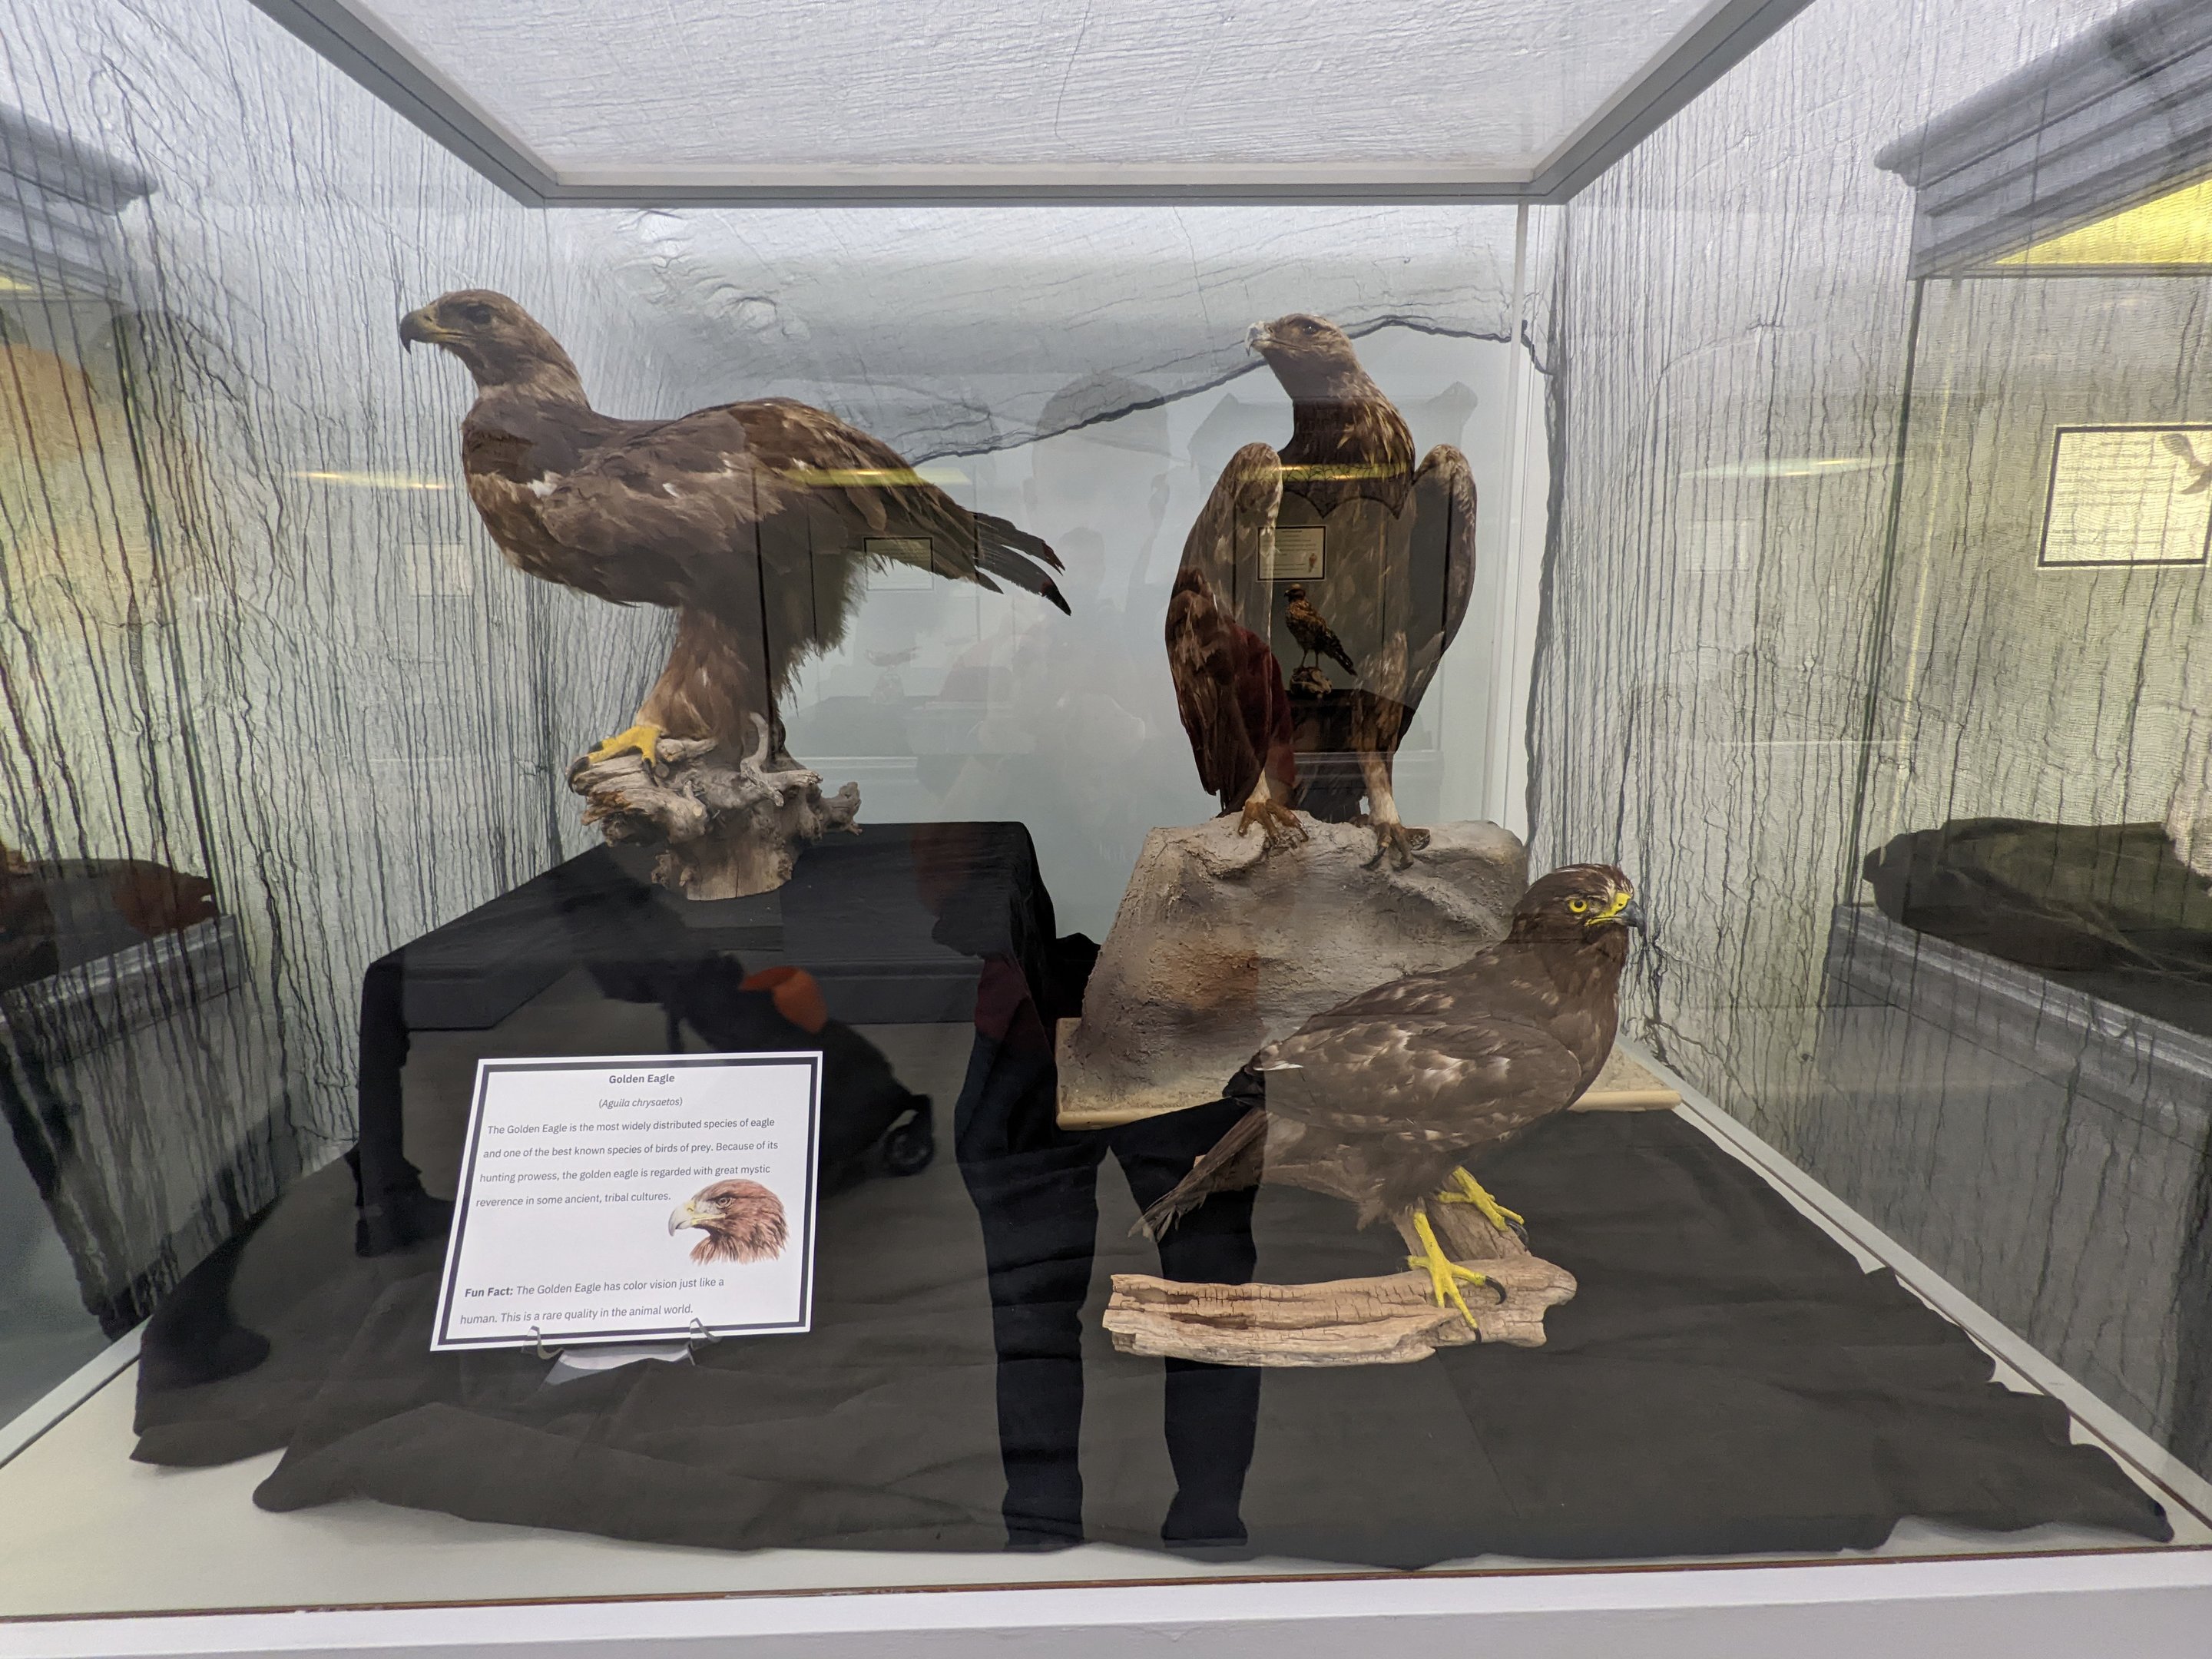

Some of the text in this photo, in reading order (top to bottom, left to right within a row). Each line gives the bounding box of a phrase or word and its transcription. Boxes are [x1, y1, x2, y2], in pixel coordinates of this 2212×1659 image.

[609, 1073, 675, 1085] Golden Eagle
[631, 1097, 683, 1108] chrysaetos)
[488, 1125, 505, 1134] The
[507, 1124, 540, 1134] Golden
[542, 1124, 568, 1134] Eagle
[569, 1123, 577, 1132] is
[579, 1123, 594, 1131] the
[621, 1121, 651, 1132] widely
[653, 1120, 702, 1130] distributed
[704, 1119, 737, 1130] species
[739, 1118, 749, 1128] of
[750, 1118, 775, 1128] eagle
[483, 1149, 502, 1158] and
[523, 1147, 533, 1157] of
[535, 1147, 550, 1157] the
[551, 1147, 572, 1156] best
[575, 1147, 605, 1155] known
[607, 1145, 642, 1156] species
[644, 1144, 654, 1154] of
[655, 1144, 678, 1153] birds
[680, 1143, 690, 1152] of
[690, 1144, 714, 1154] prey.
[716, 1142, 754, 1151] Because
[756, 1141, 766, 1150] of
[767, 1141, 778, 1149] its
[479, 1164, 770, 1184] hunting prowess, the golden eagle is regarded with great mystic
[475, 1198, 524, 1207] reverence
[525, 1196, 535, 1205] in
[565, 1194, 602, 1204] ancient,
[604, 1193, 629, 1202] tribal
[631, 1192, 671, 1201] cultures.
[465, 1288, 485, 1297] Fun
[487, 1287, 513, 1296] Fact:
[517, 1286, 535, 1295] The
[537, 1284, 572, 1294] Golden
[575, 1283, 601, 1294] Eagle
[604, 1282, 621, 1291] has
[623, 1280, 647, 1290] color
[650, 1280, 677, 1289] vision
[679, 1279, 697, 1290] just
[700, 1277, 717, 1286] like
[460, 1315, 497, 1324] human.
[501, 1312, 521, 1322] This
[523, 1311, 531, 1321] is
[542, 1312, 562, 1320] rare
[565, 1309, 598, 1321] quality
[600, 1308, 609, 1317] in
[611, 1307, 628, 1317] the
[629, 1305, 661, 1316] animal
[664, 1303, 693, 1314] world.
